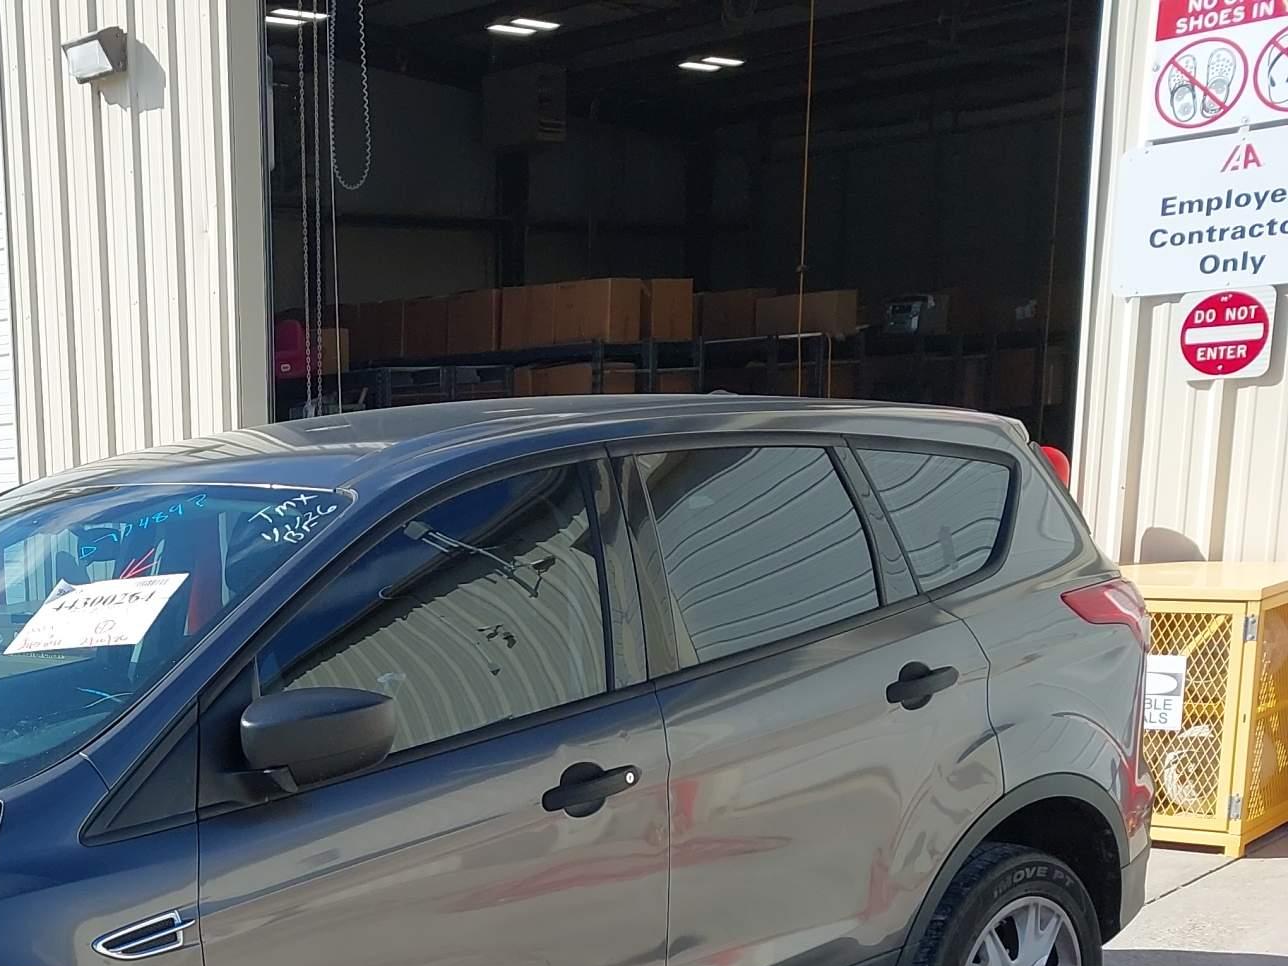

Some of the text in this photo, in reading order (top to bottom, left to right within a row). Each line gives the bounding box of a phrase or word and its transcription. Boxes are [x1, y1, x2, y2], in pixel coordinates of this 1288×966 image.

[1175, 0, 1275, 34] SHOES IN
[1199, 250, 1267, 275] Only
[1194, 304, 1259, 324] DO NOT
[1196, 344, 1248, 362] ENTER
